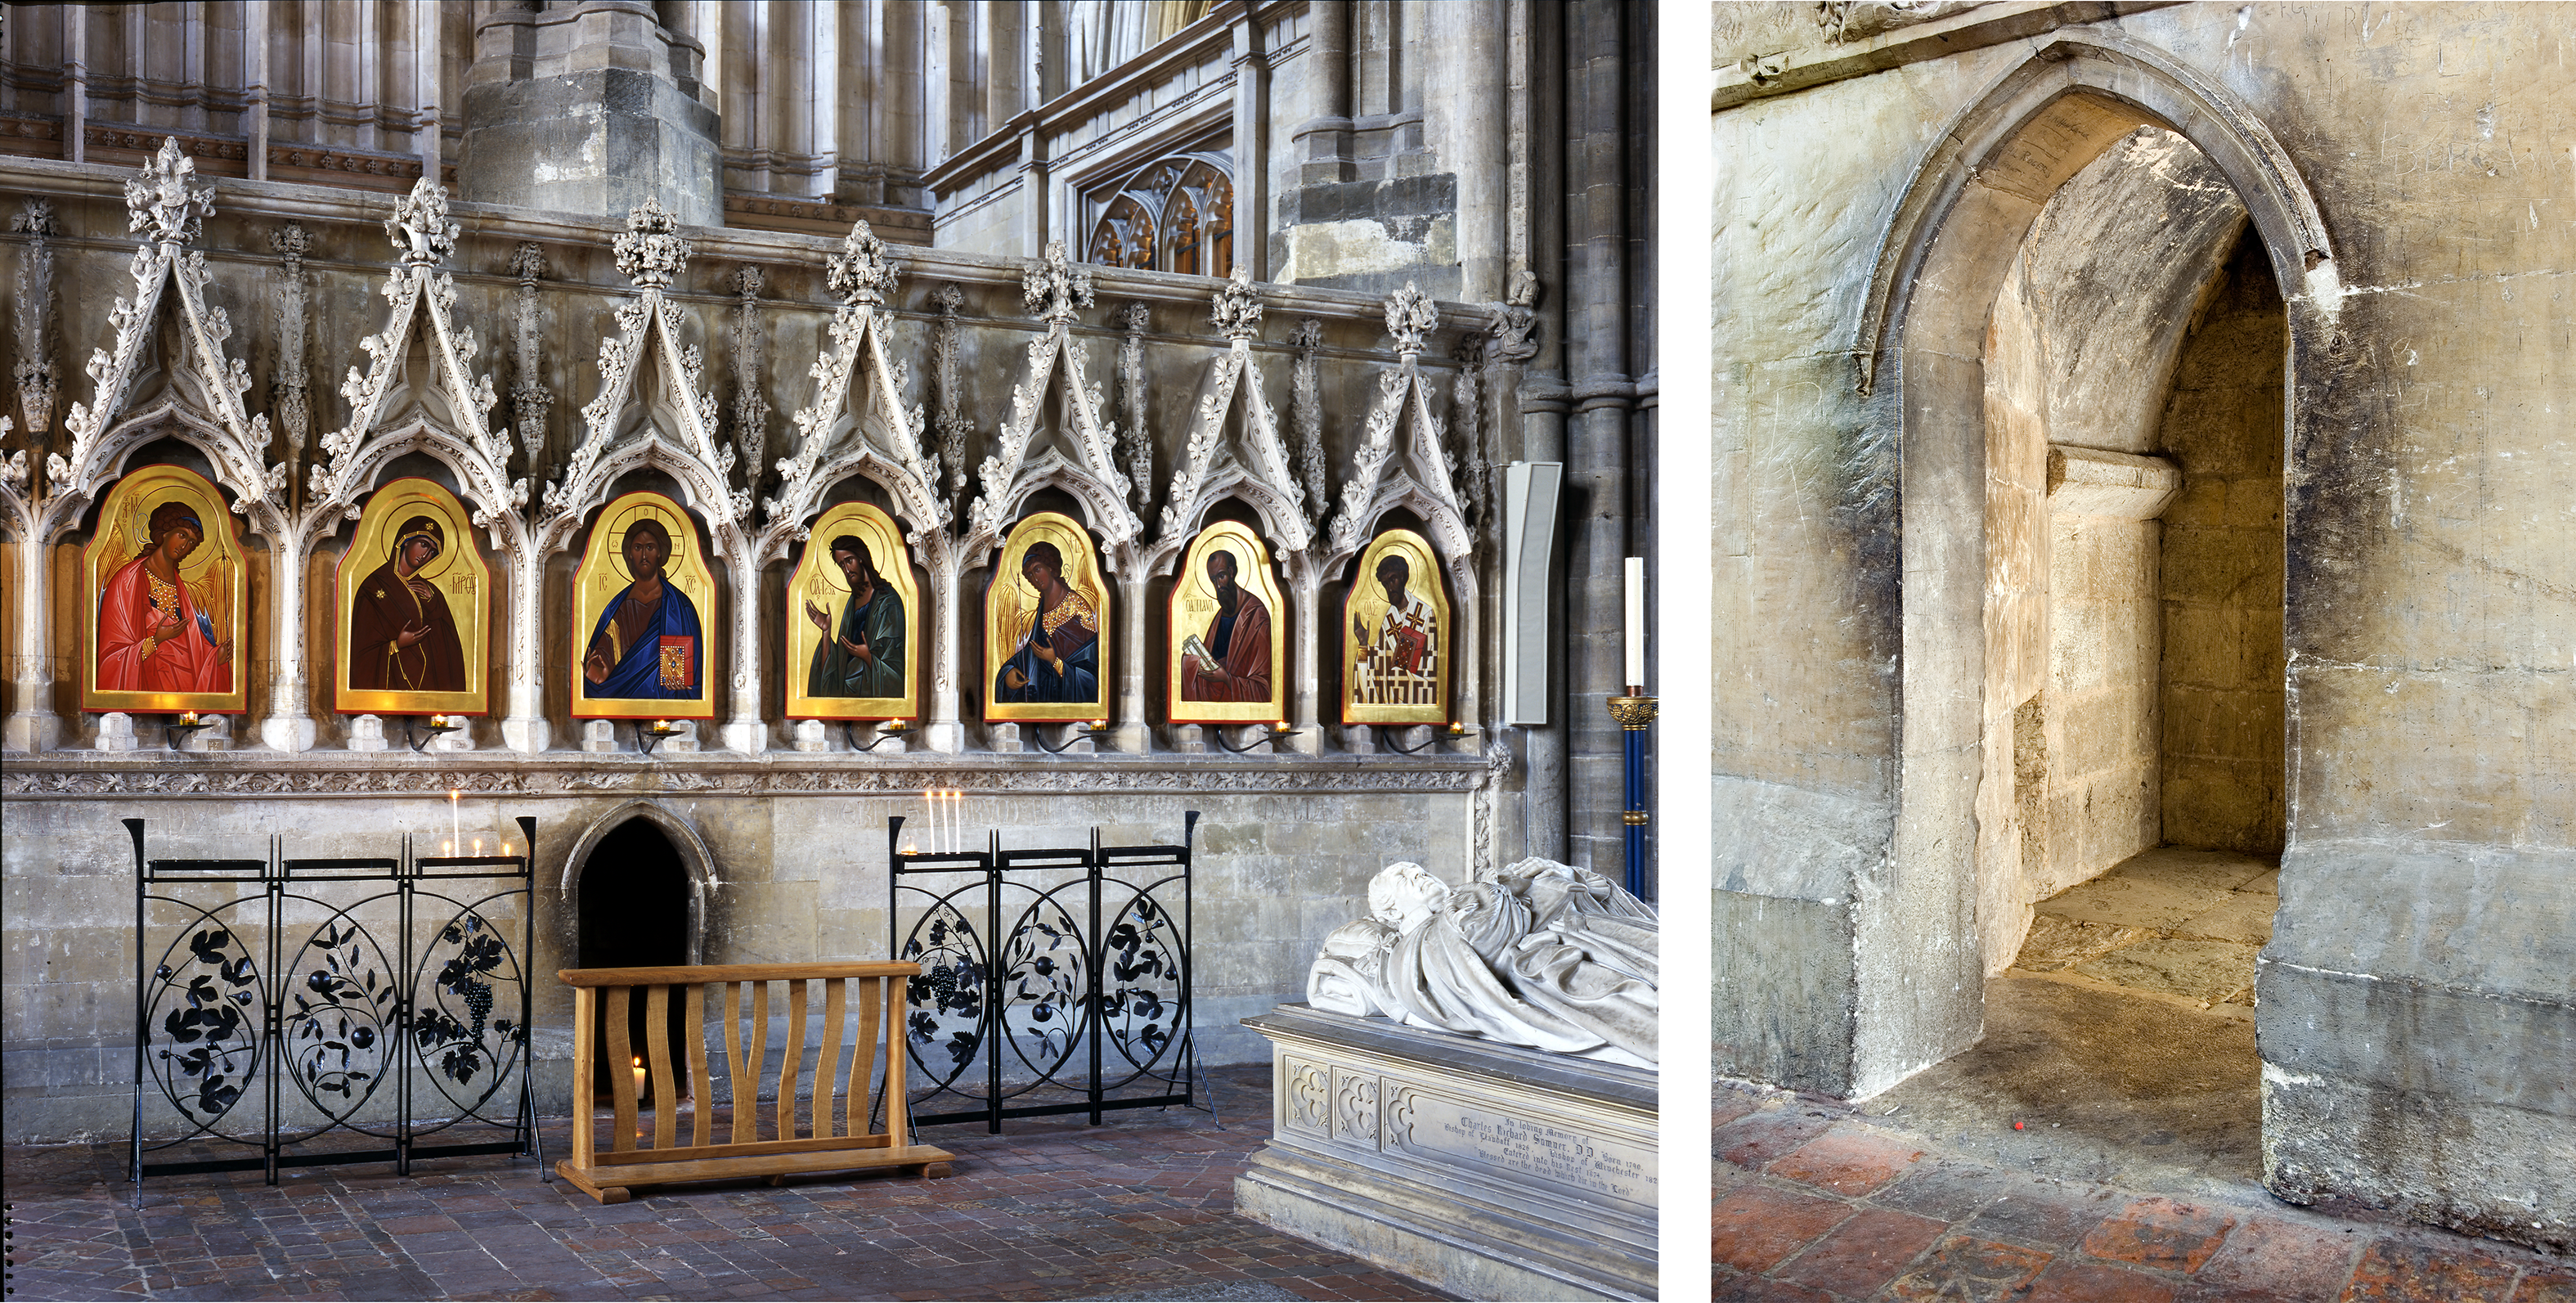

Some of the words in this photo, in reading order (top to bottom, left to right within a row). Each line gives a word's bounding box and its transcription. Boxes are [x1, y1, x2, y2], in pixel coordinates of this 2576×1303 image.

[1461, 1117, 1492, 1133] Charles
[1497, 1124, 1528, 1142] Richard
[1601, 1151, 1621, 1166] Born
[1505, 1117, 1514, 1126] In
[1519, 1121, 1542, 1136] loving
[1545, 1128, 1577, 1143] Memory
[1582, 1135, 1589, 1145] of
[1444, 1123, 1465, 1138] Bishop
[1468, 1130, 1475, 1138] of
[1479, 1131, 1510, 1146] Llandaff
[1549, 1148, 1575, 1163] Bishop
[1581, 1157, 1588, 1166] of
[1594, 1160, 1640, 1179] Winchester
[1645, 1175, 1658, 1184] 182
[1503, 1148, 1529, 1161] Entered
[1533, 1154, 1548, 1165] into
[1551, 1158, 1563, 1169] his
[1566, 1162, 1582, 1174] Rest
[1521, 1160, 1532, 1170] the
[1535, 1162, 1551, 1175] dead
[1555, 1169, 1575, 1182] which
[1577, 1175, 1587, 1184] die
[1589, 1179, 1596, 1188] in
[1599, 1180, 1608, 1191] the
